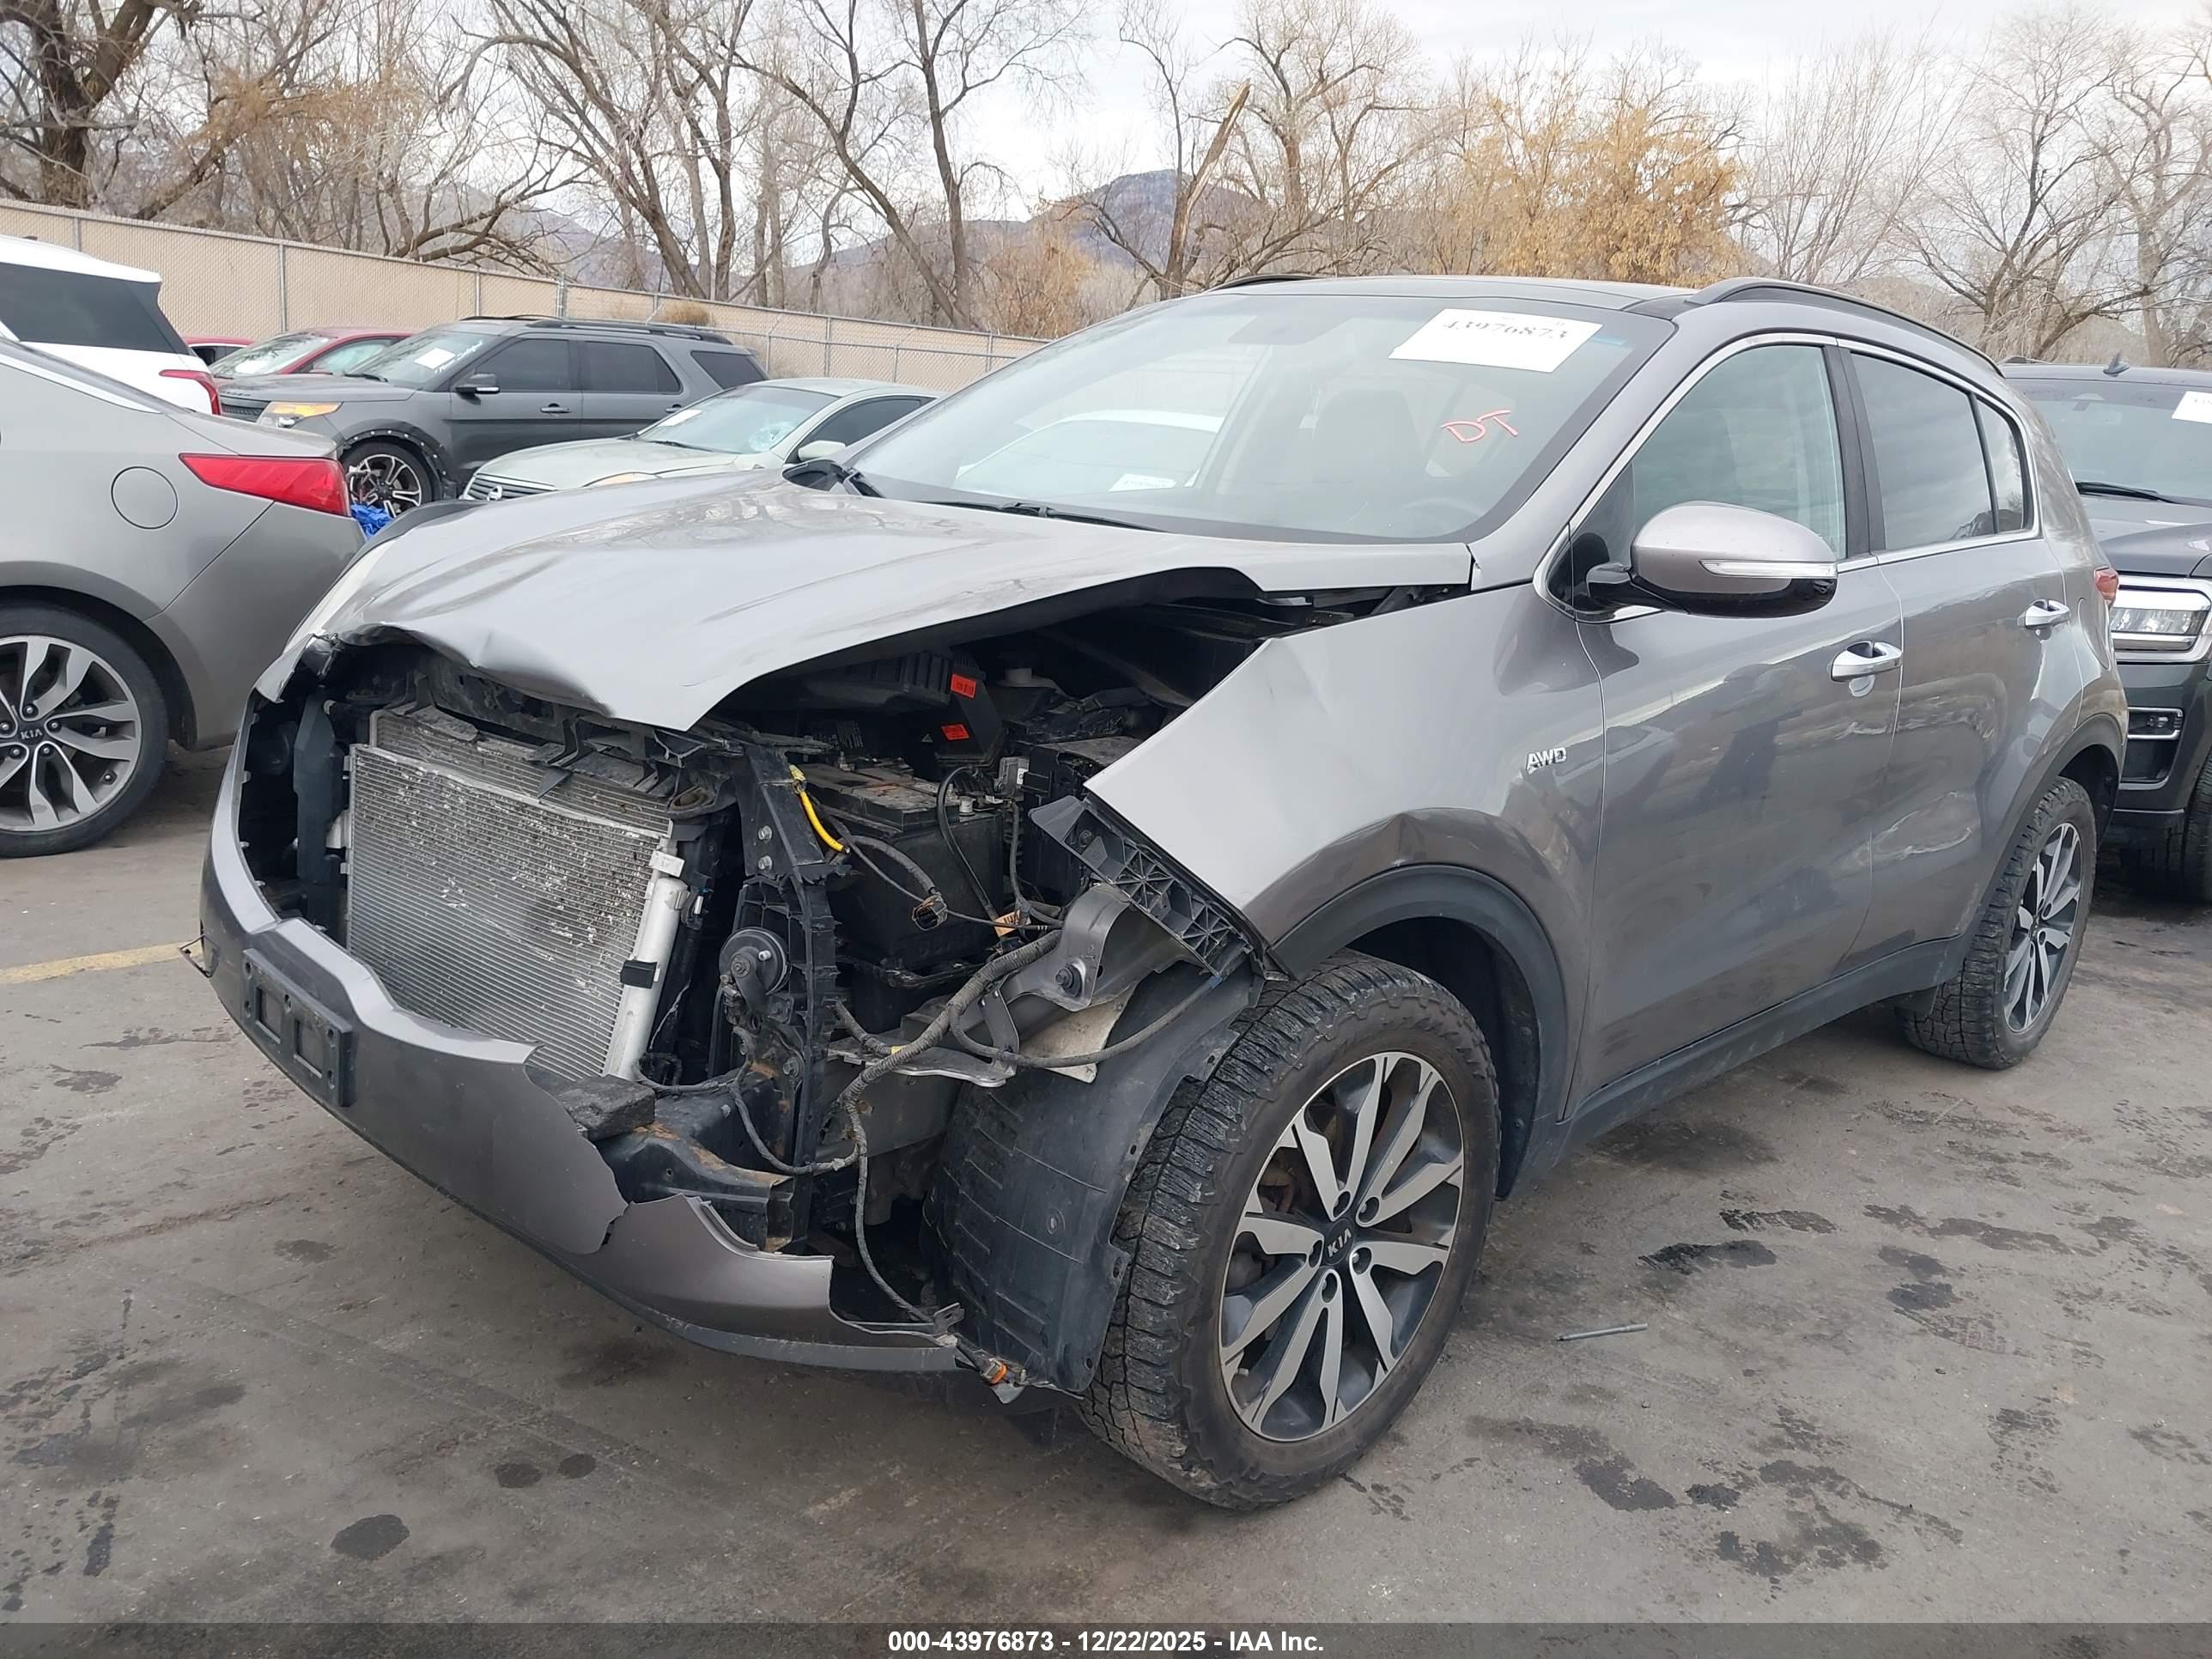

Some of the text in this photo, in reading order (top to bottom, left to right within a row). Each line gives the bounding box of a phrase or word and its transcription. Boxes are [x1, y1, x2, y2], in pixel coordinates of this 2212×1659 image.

[21, 728, 43, 739] KIA
[1526, 747, 1567, 772] AWD
[1328, 1228, 1352, 1258] KIA
